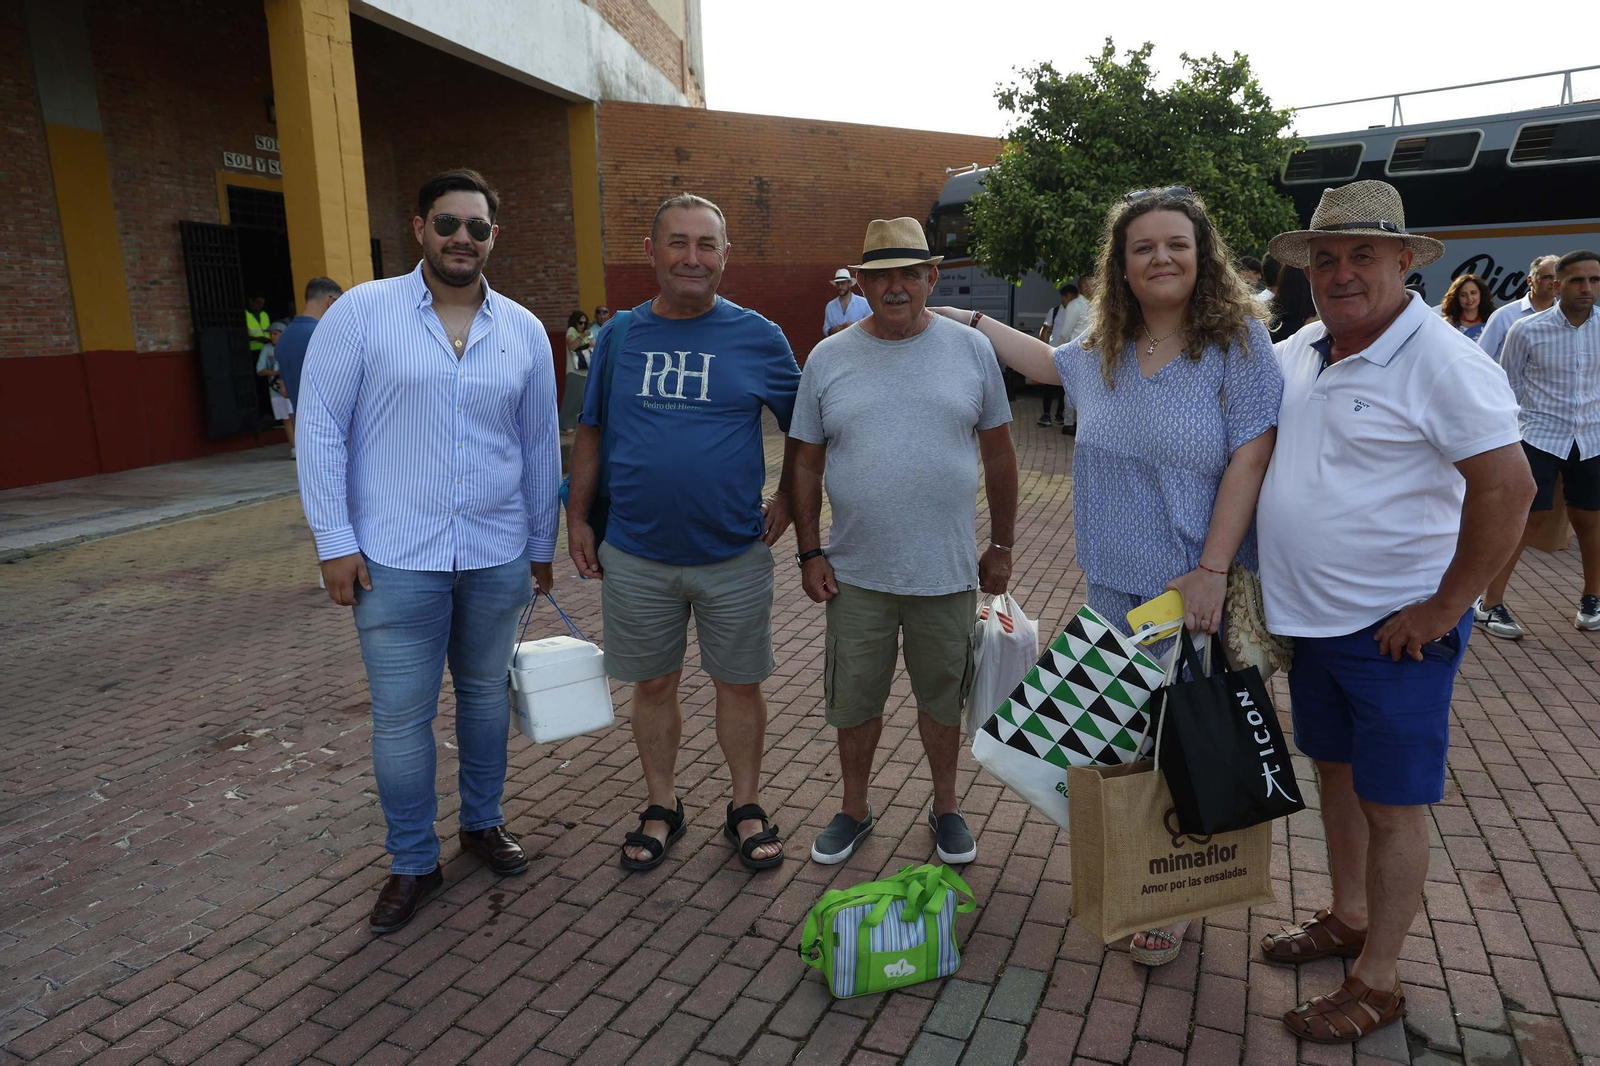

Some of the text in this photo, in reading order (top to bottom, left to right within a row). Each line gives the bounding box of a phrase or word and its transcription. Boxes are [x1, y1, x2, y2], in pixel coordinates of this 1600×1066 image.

[225, 153, 252, 168] SOL
[256, 158, 265, 170] Y
[643, 400, 664, 410] Pedro
[665, 401, 676, 410] del
[1149, 844, 1238, 875] mimaflor
[1141, 866, 1247, 895] Amor por las ensaladas
